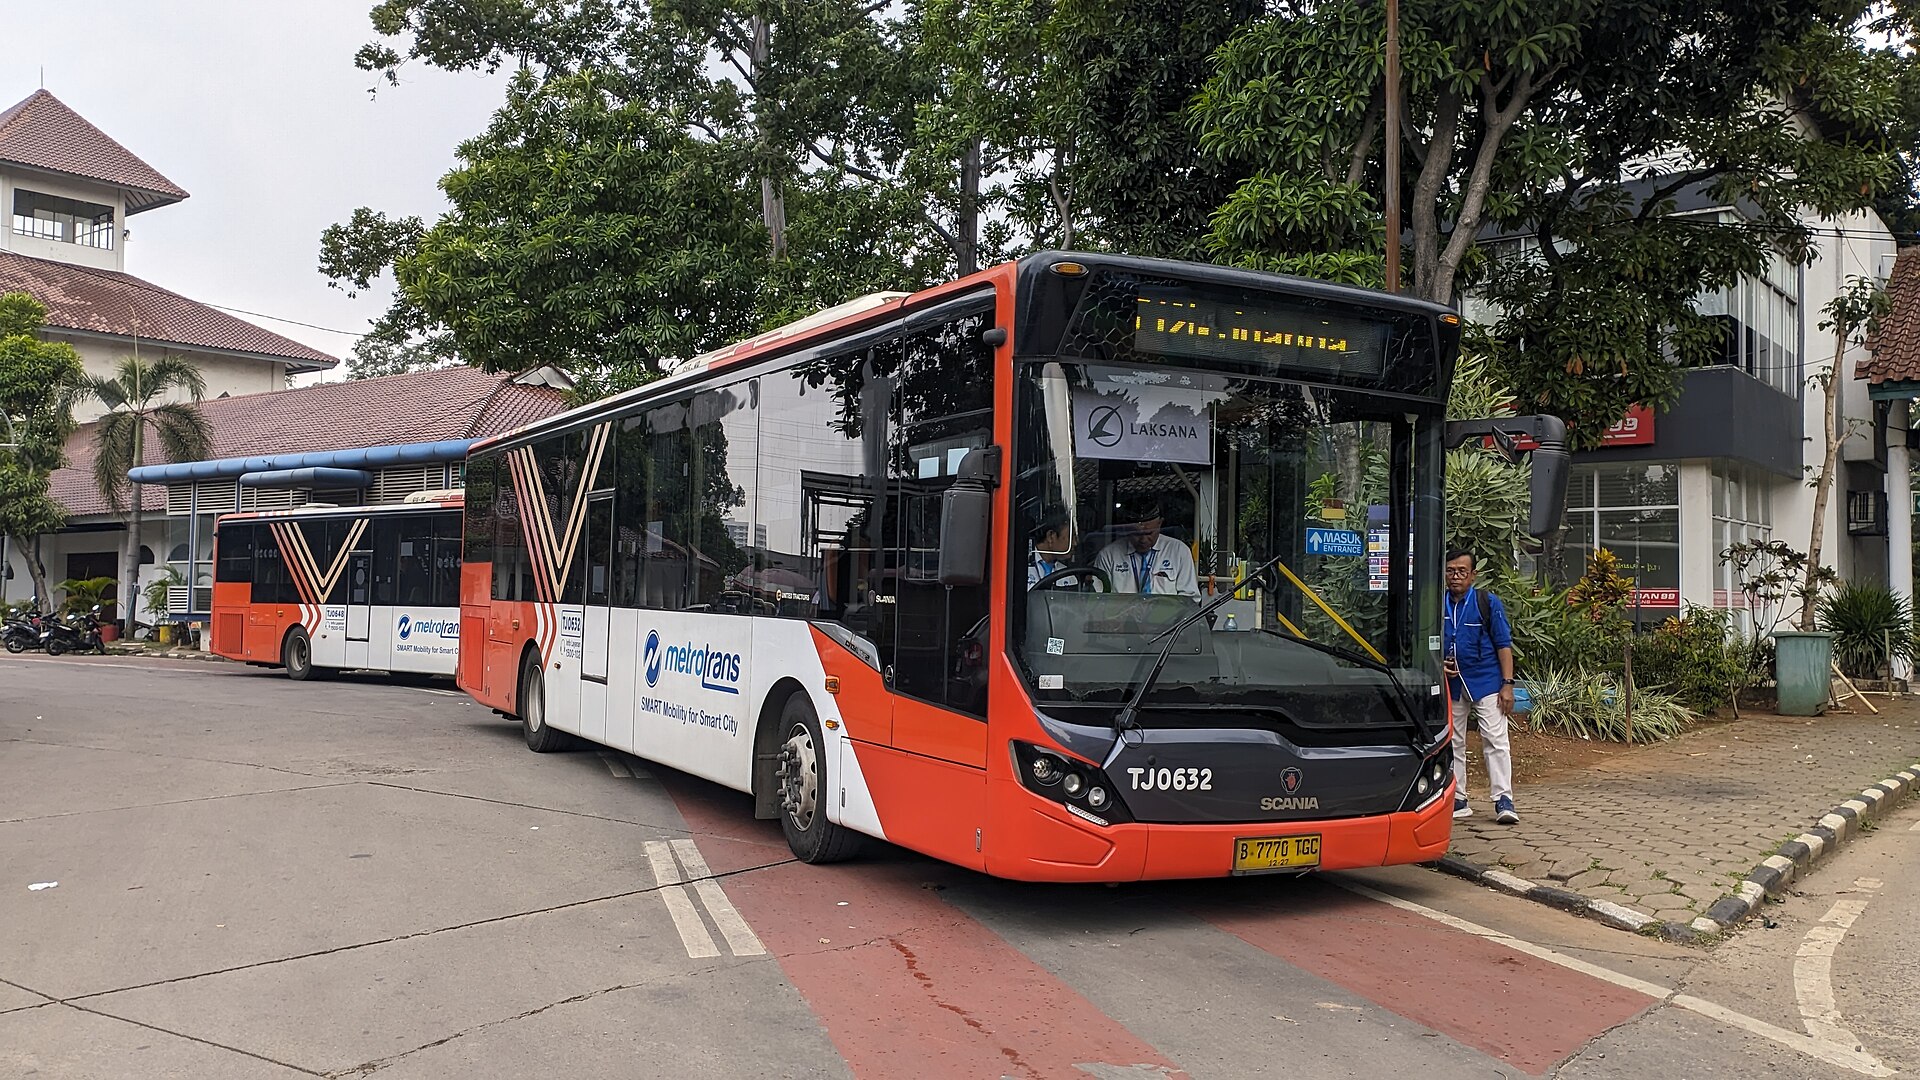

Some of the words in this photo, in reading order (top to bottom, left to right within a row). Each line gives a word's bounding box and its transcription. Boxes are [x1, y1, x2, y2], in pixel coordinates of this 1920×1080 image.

[1130, 422, 1198, 439] LAKSANA
[1323, 531, 1361, 545] MASUK
[1323, 544, 1362, 554] ENTRANCE
[327, 610, 345, 618] TJ0648
[413, 619, 459, 638] metrotran
[562, 615, 581, 632] TJ0632
[397, 644, 413, 652] SMART
[413, 645, 431, 654] Mobility
[439, 646, 454, 654] Smart
[665, 640, 740, 693] metrotrans
[641, 696, 662, 715] SMART
[663, 701, 687, 725] Mobility
[688, 706, 698, 724] for
[700, 709, 722, 730] Smart
[723, 714, 738, 737] City
[1127, 767, 1213, 791] TJ0632
[1260, 797, 1319, 811] SCANIA
[1240, 843, 1248, 860] B
[1256, 841, 1288, 859] 7770
[1295, 838, 1319, 856] TGC
